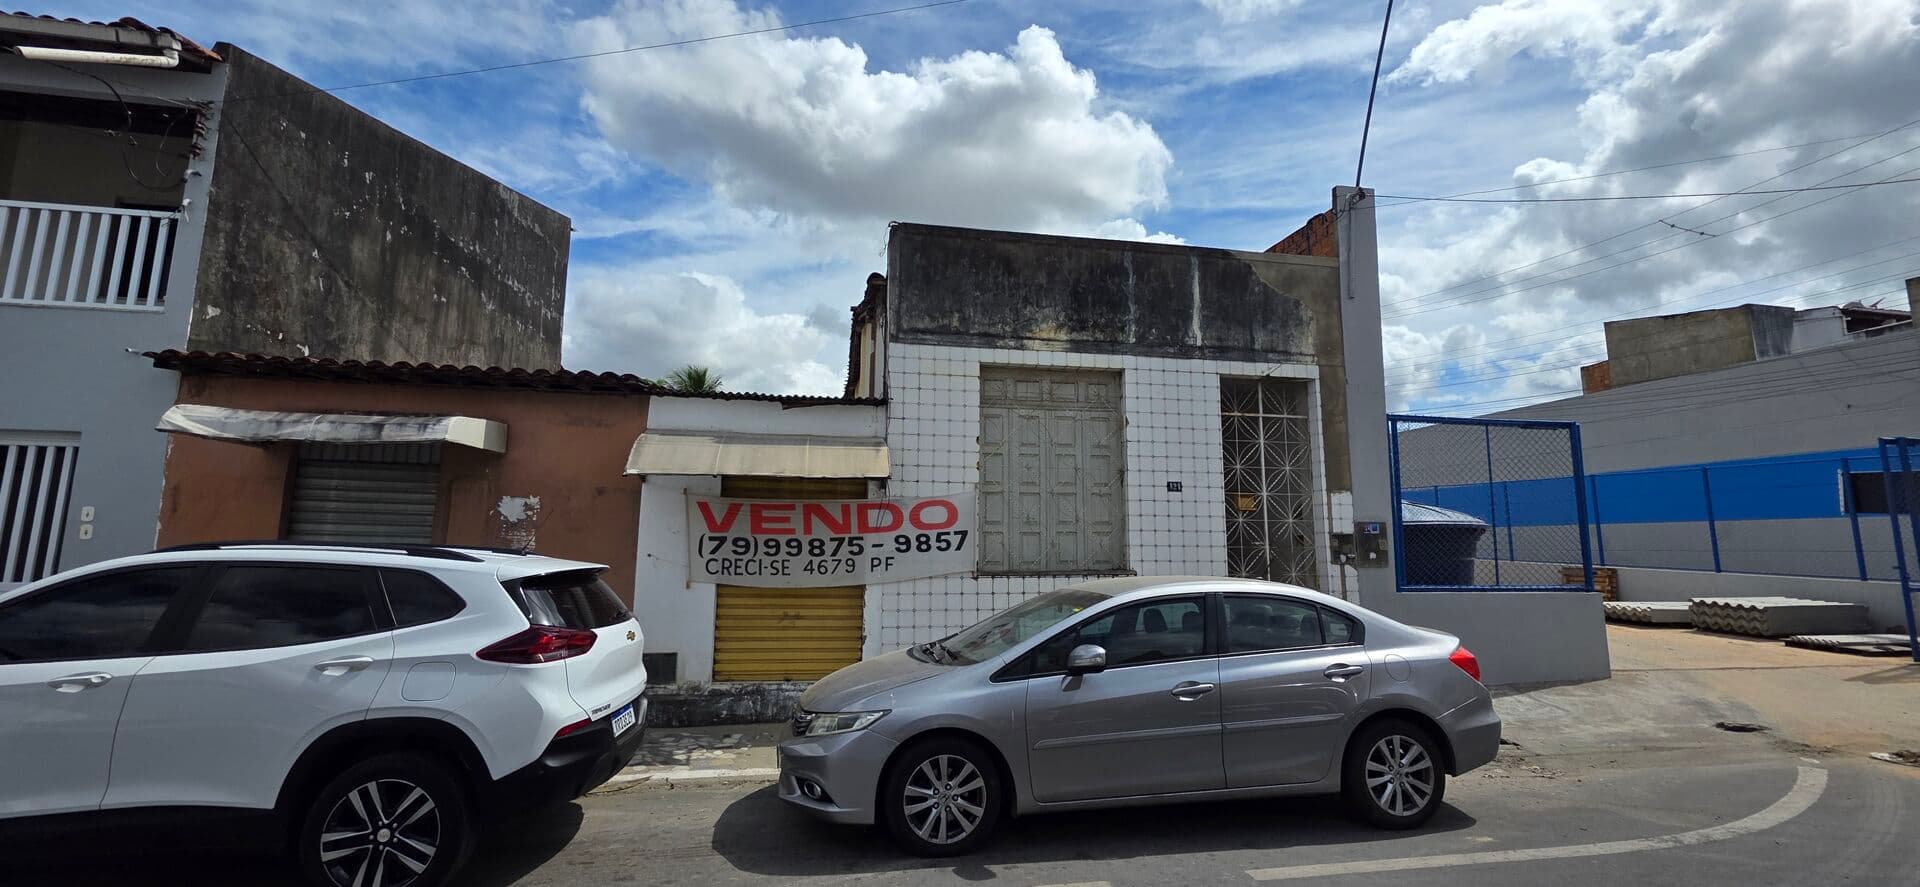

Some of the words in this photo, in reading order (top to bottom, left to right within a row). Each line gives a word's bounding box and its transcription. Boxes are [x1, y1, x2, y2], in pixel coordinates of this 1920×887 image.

[696, 499, 959, 536] VENDO
[705, 558, 791, 576] CRECI-SE
[803, 558, 856, 576] 4679
[870, 557, 896, 573] PF
